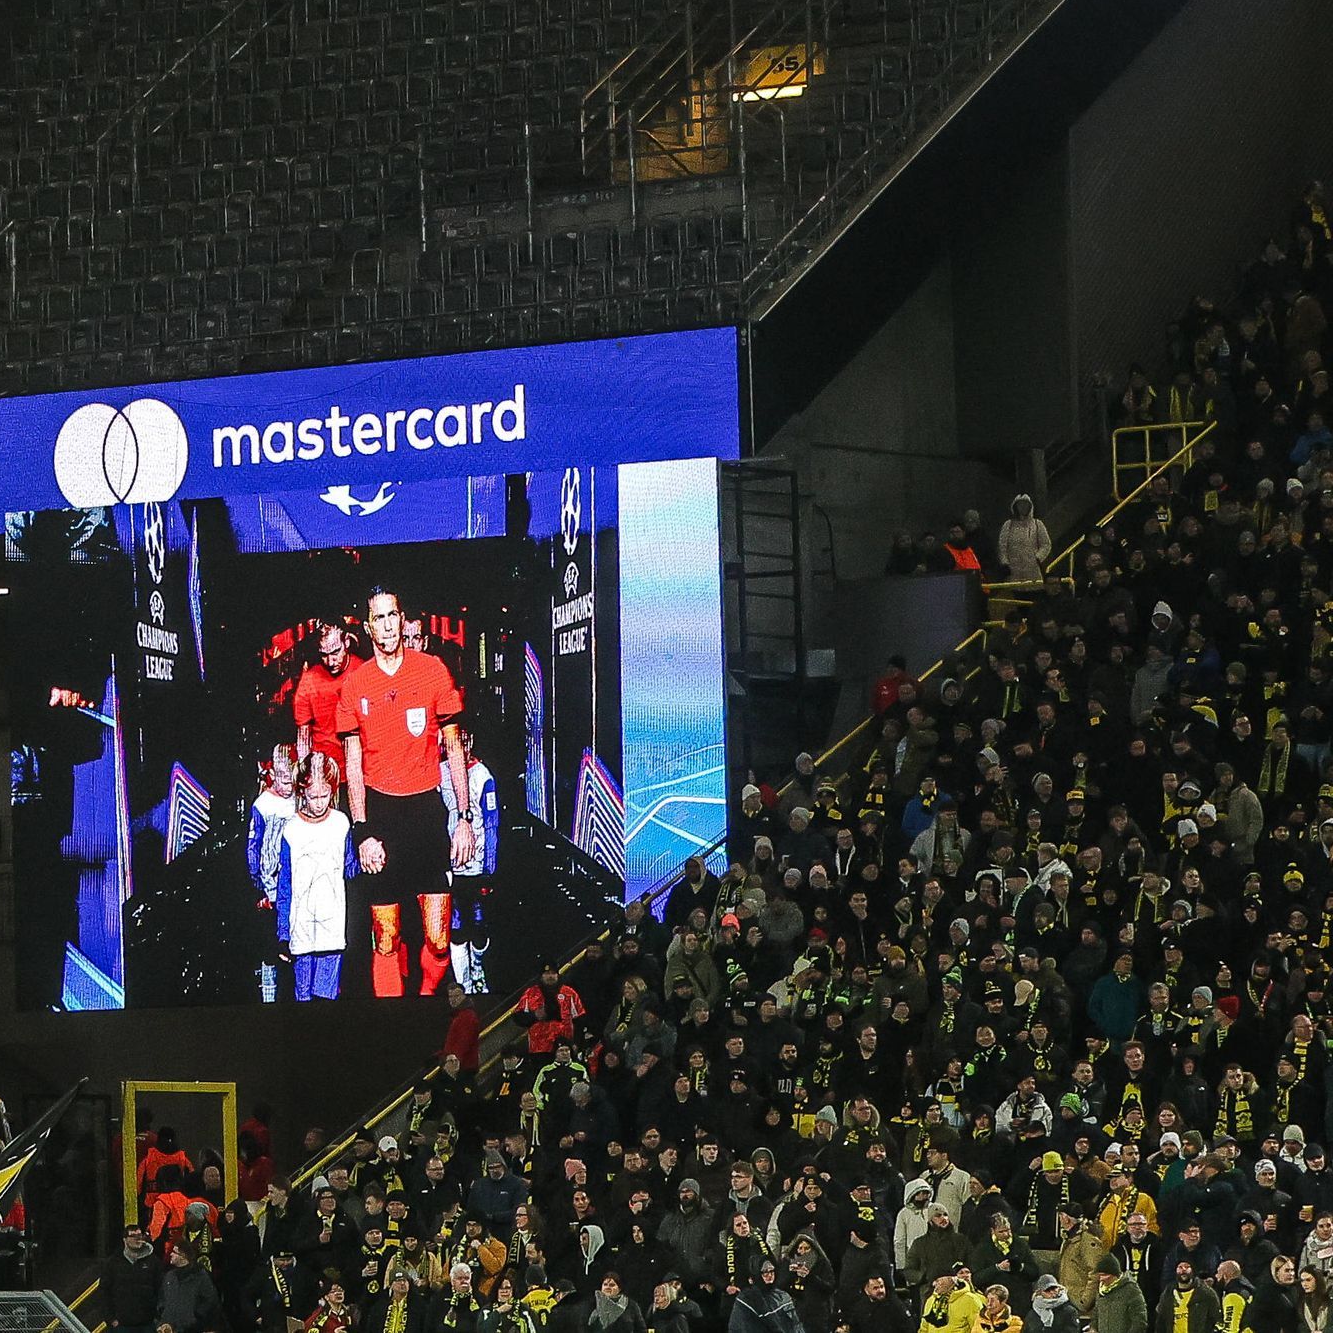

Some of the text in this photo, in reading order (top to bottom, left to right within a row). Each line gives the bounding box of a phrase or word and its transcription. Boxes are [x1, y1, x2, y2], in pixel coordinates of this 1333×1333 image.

[213, 384, 526, 468] mastercard
[553, 592, 593, 629] CHAMPIONS
[137, 621, 179, 655] CHAMPIONS
